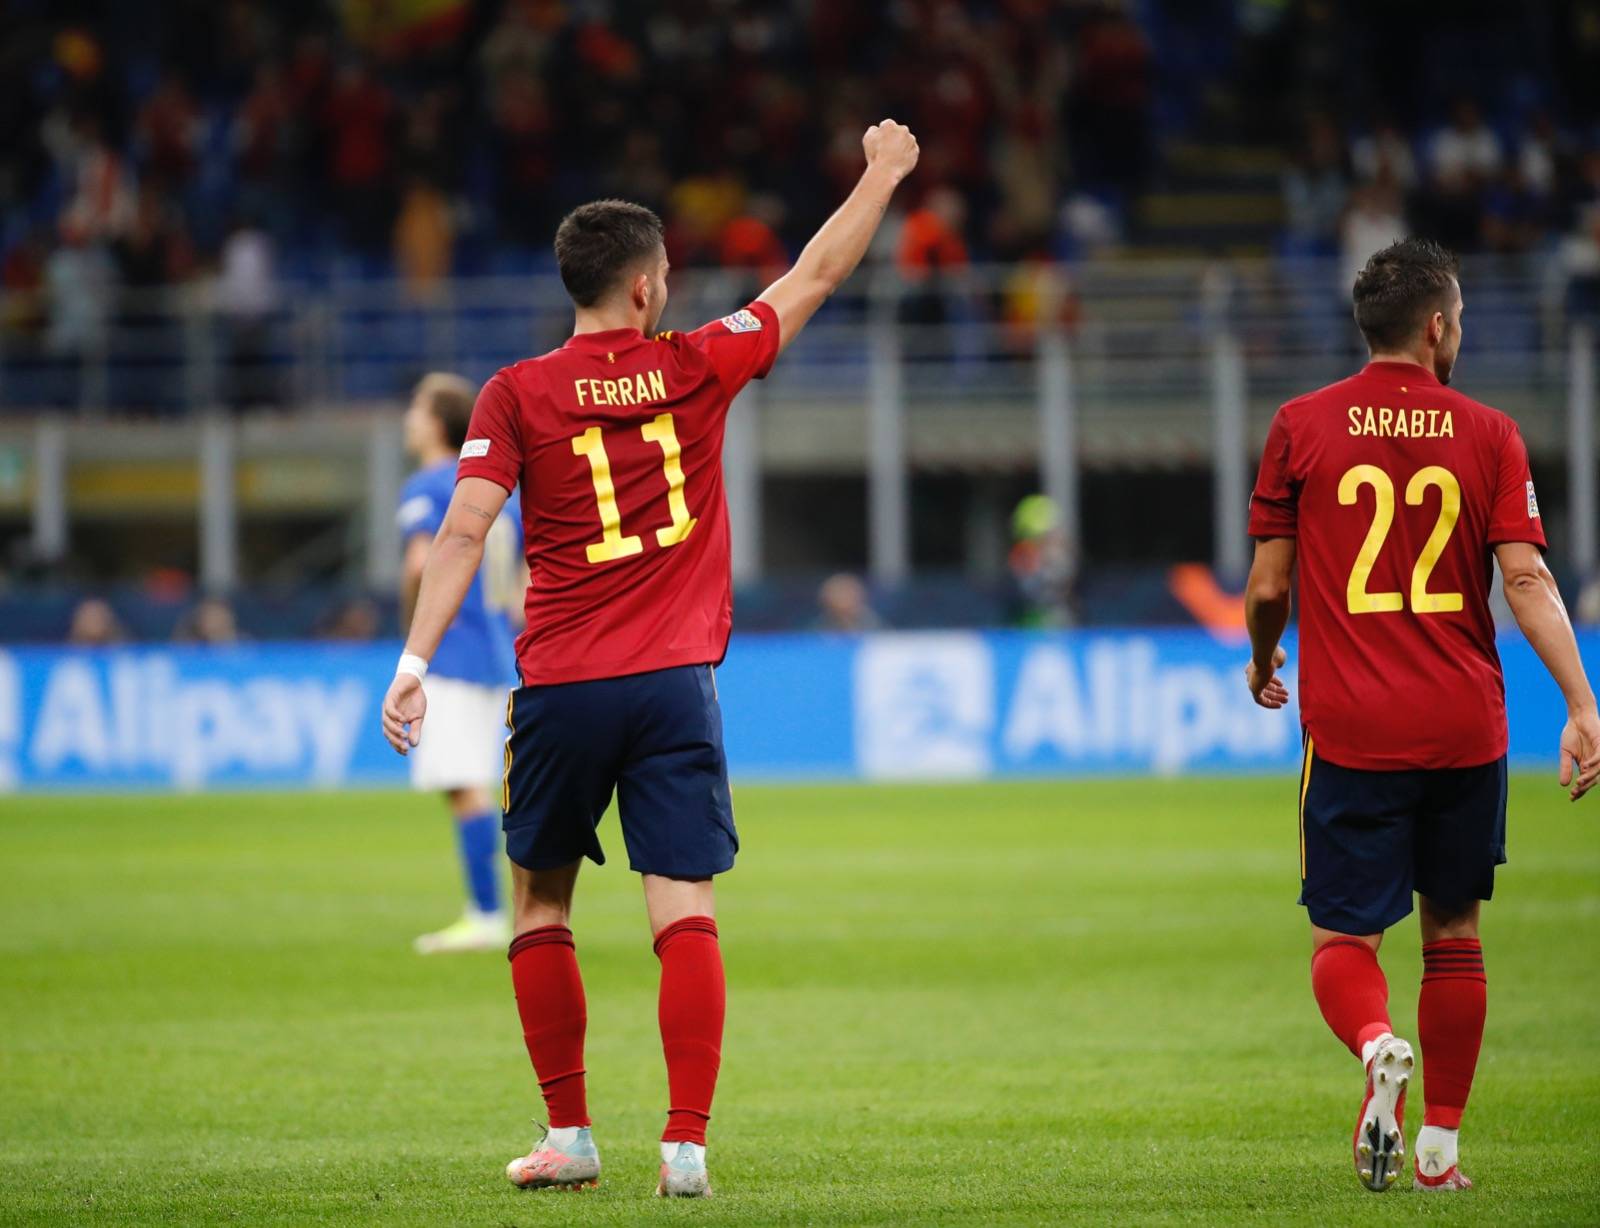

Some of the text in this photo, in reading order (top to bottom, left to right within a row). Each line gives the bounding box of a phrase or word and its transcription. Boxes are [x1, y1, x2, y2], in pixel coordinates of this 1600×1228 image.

[574, 369, 667, 407] FERRAN
[1347, 406, 1455, 438] SARABIA
[571, 412, 699, 564] 11
[1337, 464, 1464, 615] 22
[33, 654, 368, 790] Alipay
[1003, 637, 1298, 774] Alipa
